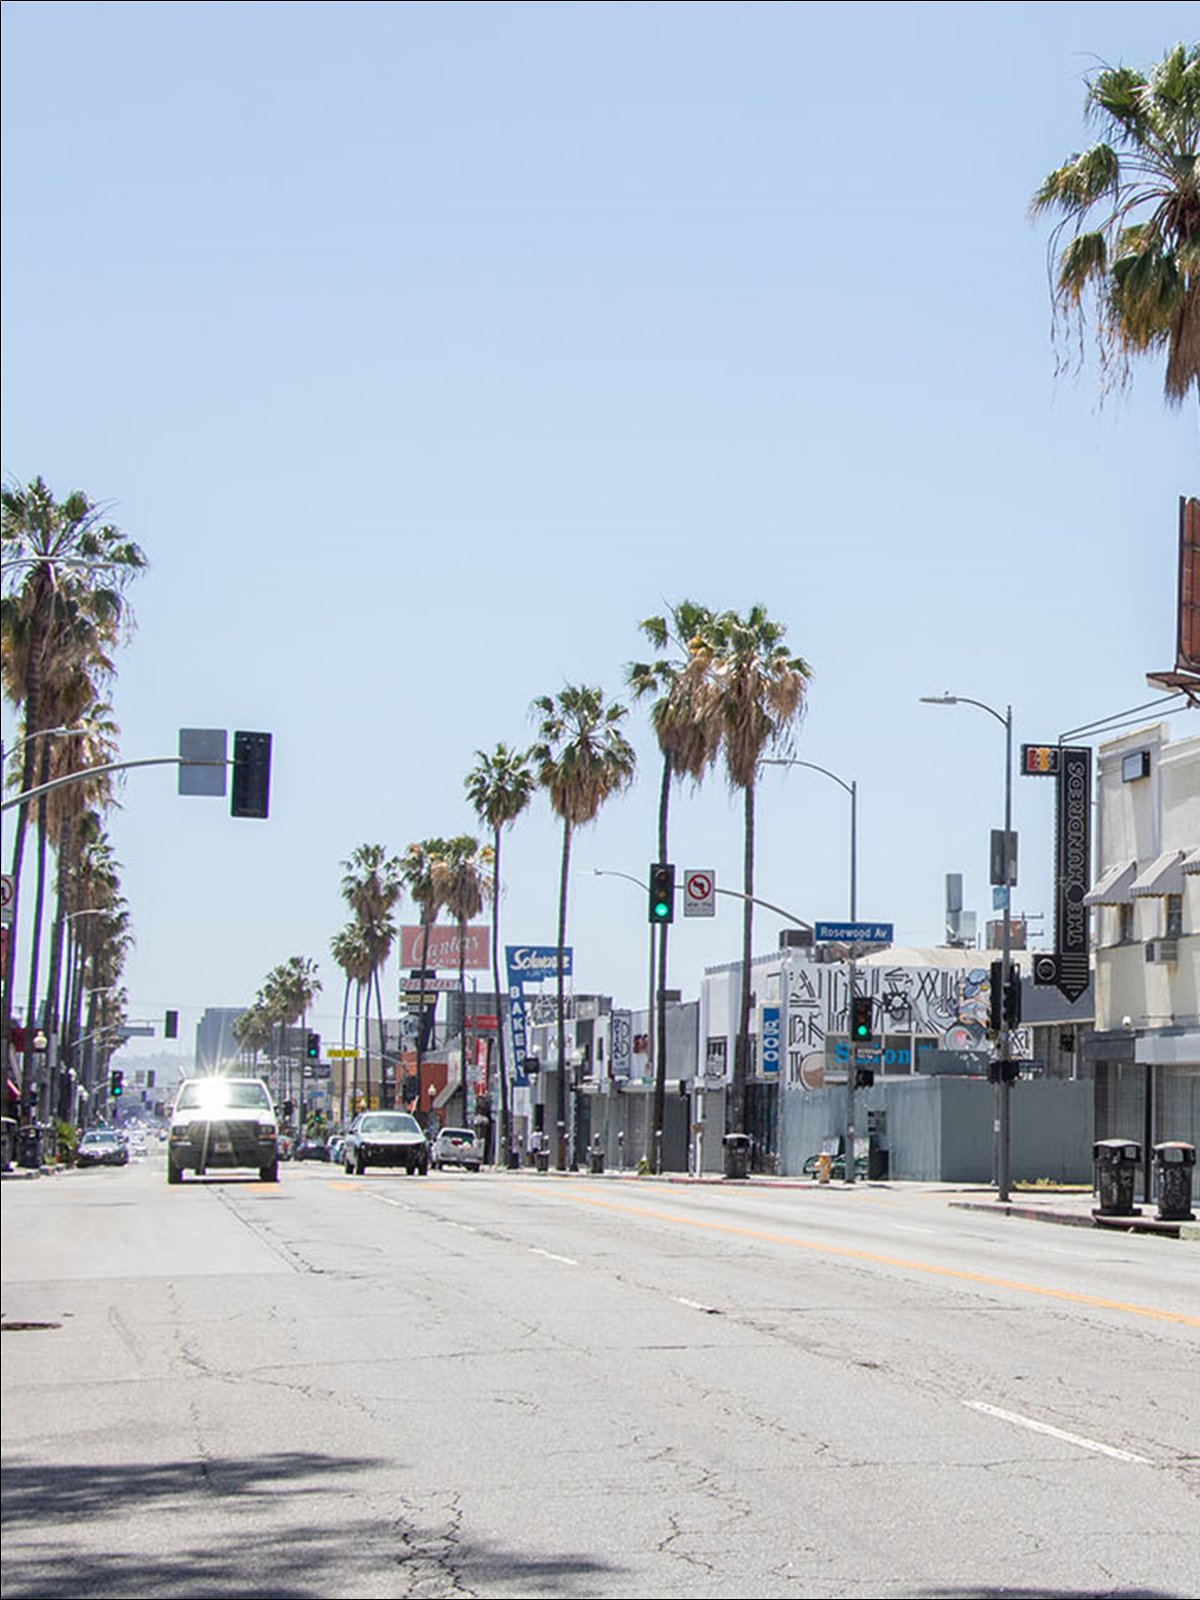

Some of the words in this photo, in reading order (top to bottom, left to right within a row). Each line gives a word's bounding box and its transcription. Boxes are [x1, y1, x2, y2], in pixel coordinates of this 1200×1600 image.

[1068, 761, 1085, 878] HUNDREDS
[820, 926, 871, 939] Rosewood
[874, 926, 889, 938] Av
[1067, 902, 1085, 946] THE
[510, 986, 526, 1078] BAKERY
